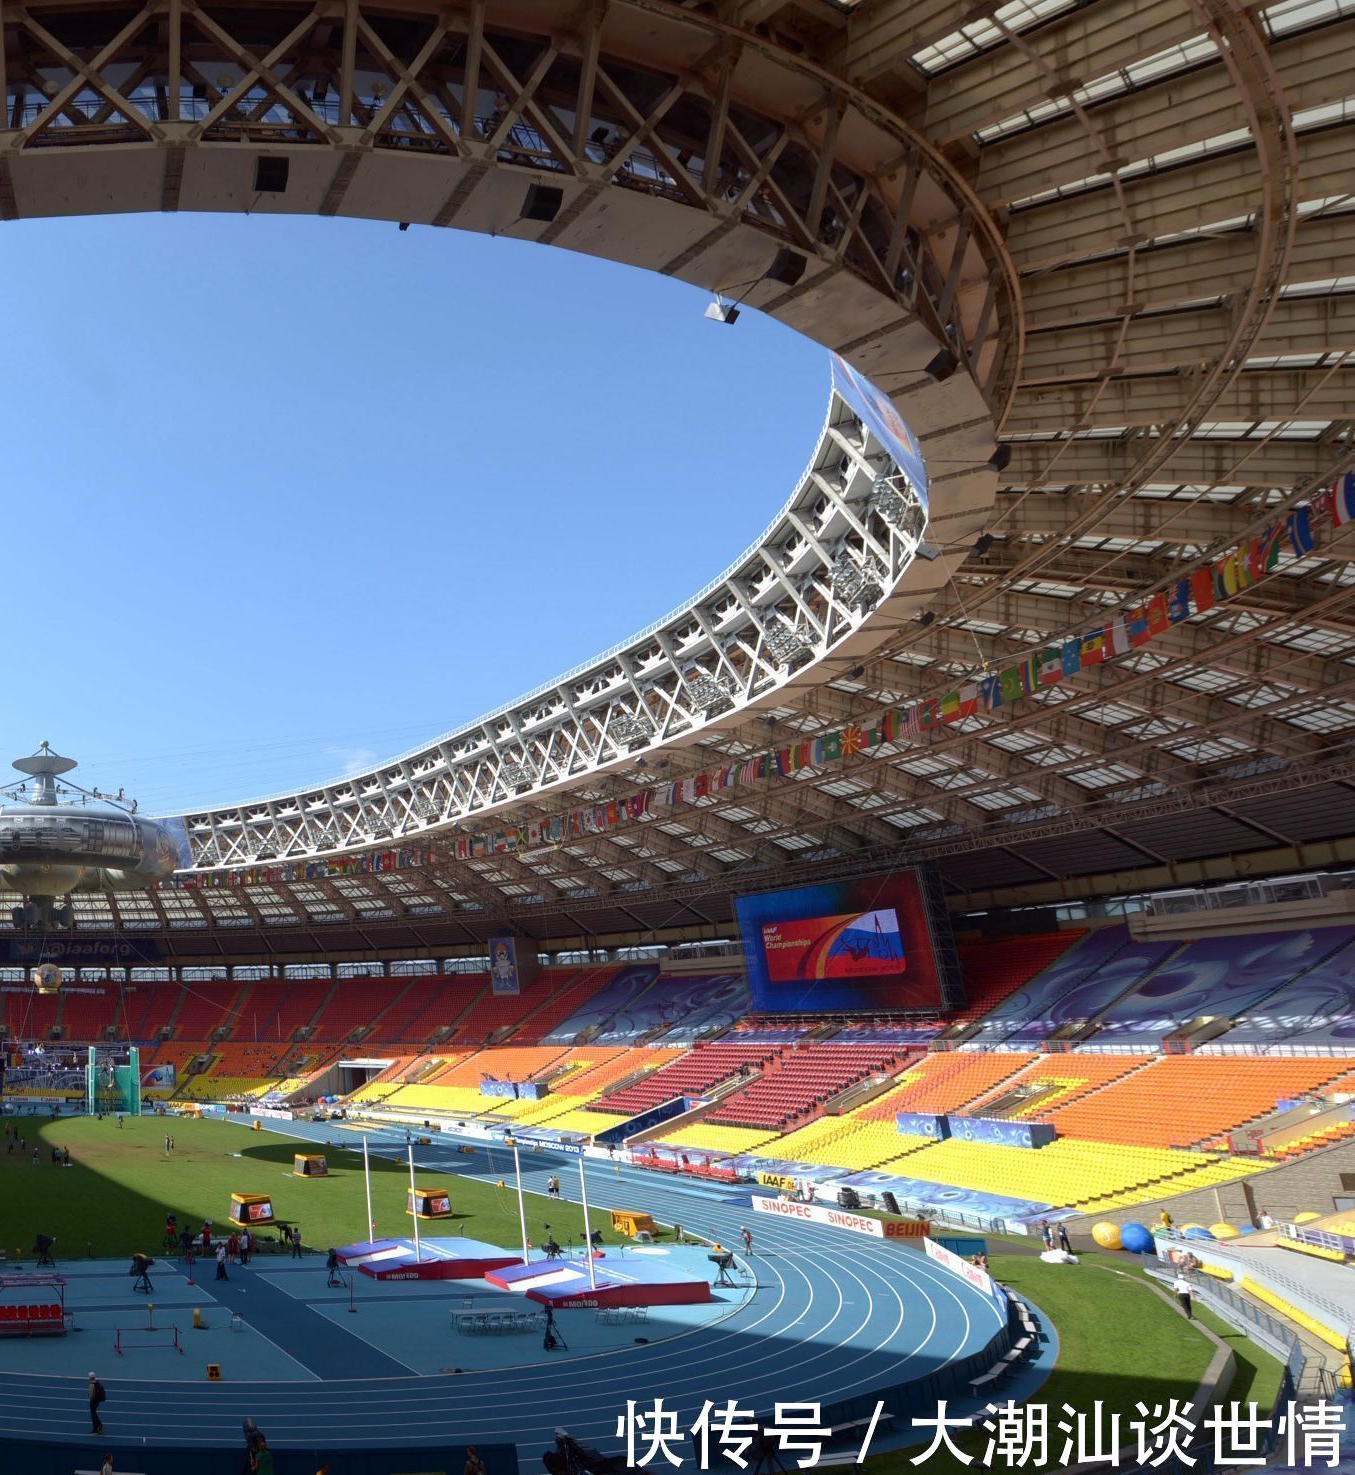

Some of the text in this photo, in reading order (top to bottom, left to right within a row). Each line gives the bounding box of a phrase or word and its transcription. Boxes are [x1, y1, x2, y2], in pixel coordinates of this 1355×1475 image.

[764, 934, 782, 942] World
[765, 939, 811, 949] Championships
[46, 942, 130, 957] @iaaforg
[539, 1140, 565, 1151] MOSCOW
[565, 1144, 580, 1154] 2013
[763, 1174, 786, 1188] IAAF
[762, 1199, 874, 1232] SINOPEC SINOPEC
